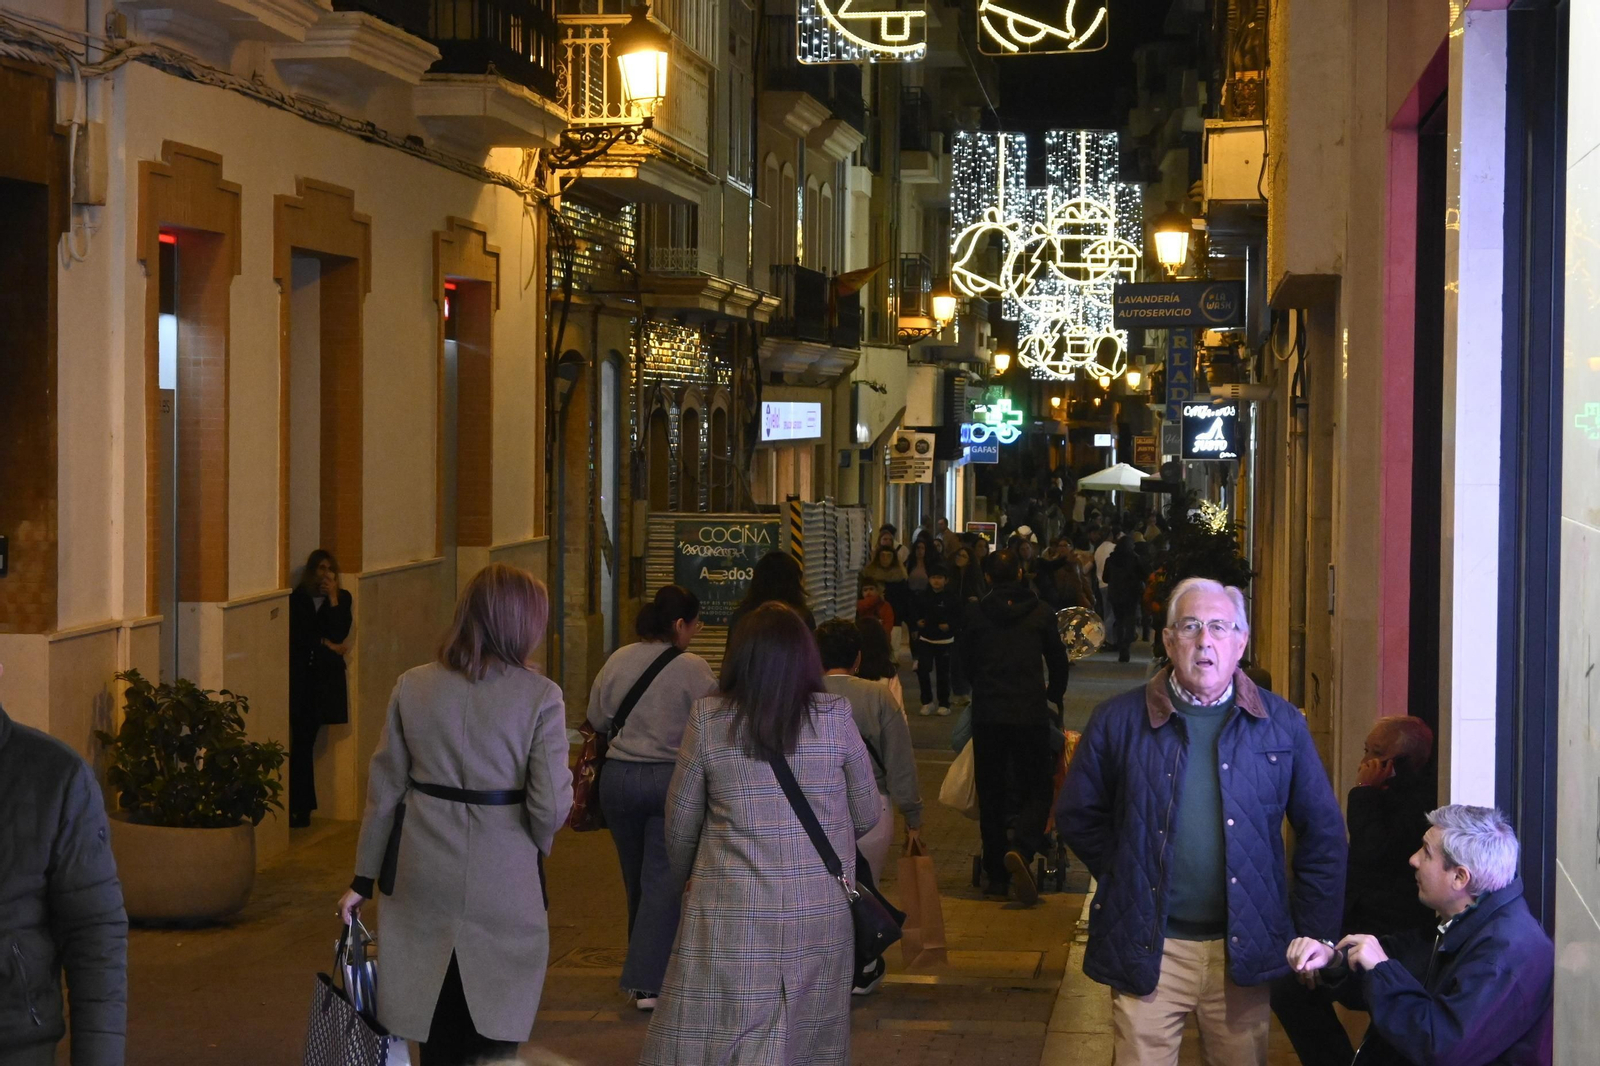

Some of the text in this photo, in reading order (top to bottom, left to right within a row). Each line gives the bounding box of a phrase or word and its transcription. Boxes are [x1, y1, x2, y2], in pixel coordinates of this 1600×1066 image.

[1118, 292, 1180, 304] LAVANDERÍA
[1215, 292, 1226, 301] LA
[1118, 308, 1192, 318] AUTOSERVICIO
[699, 527, 771, 543] COCINA
